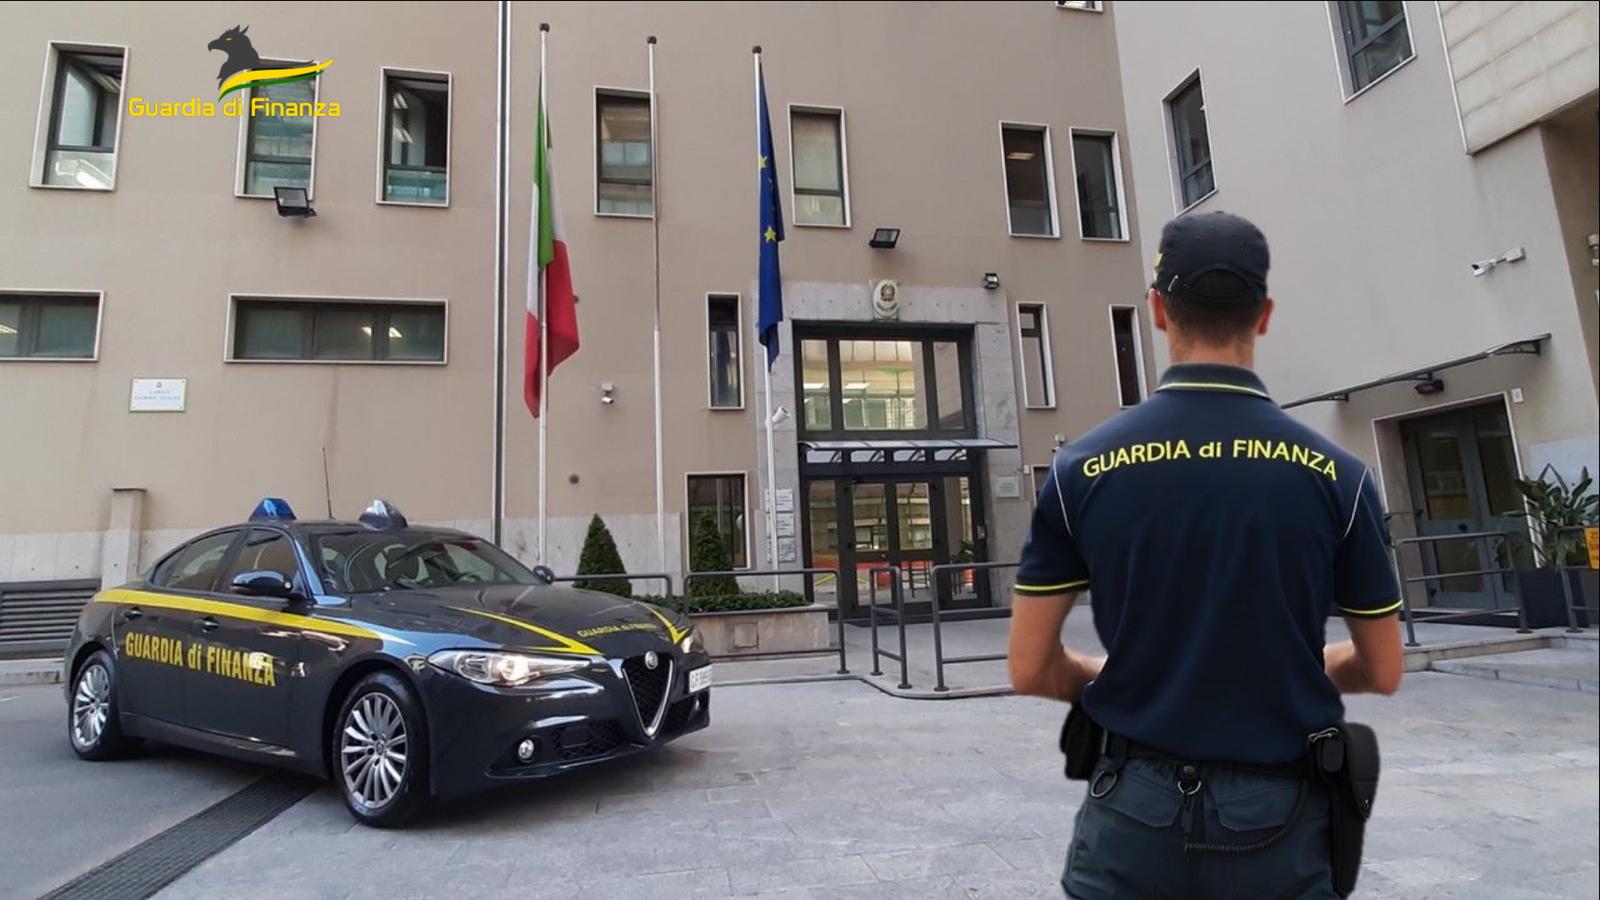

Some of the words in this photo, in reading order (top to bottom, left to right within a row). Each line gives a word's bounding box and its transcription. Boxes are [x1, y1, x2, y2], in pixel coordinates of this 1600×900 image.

[1083, 440, 1191, 477] GUARDIA
[1199, 442, 1221, 458] di
[1233, 439, 1337, 480] FINANZA
[125, 632, 183, 667] GUARDIA
[187, 643, 201, 670] di
[207, 646, 276, 687] FINANZA
